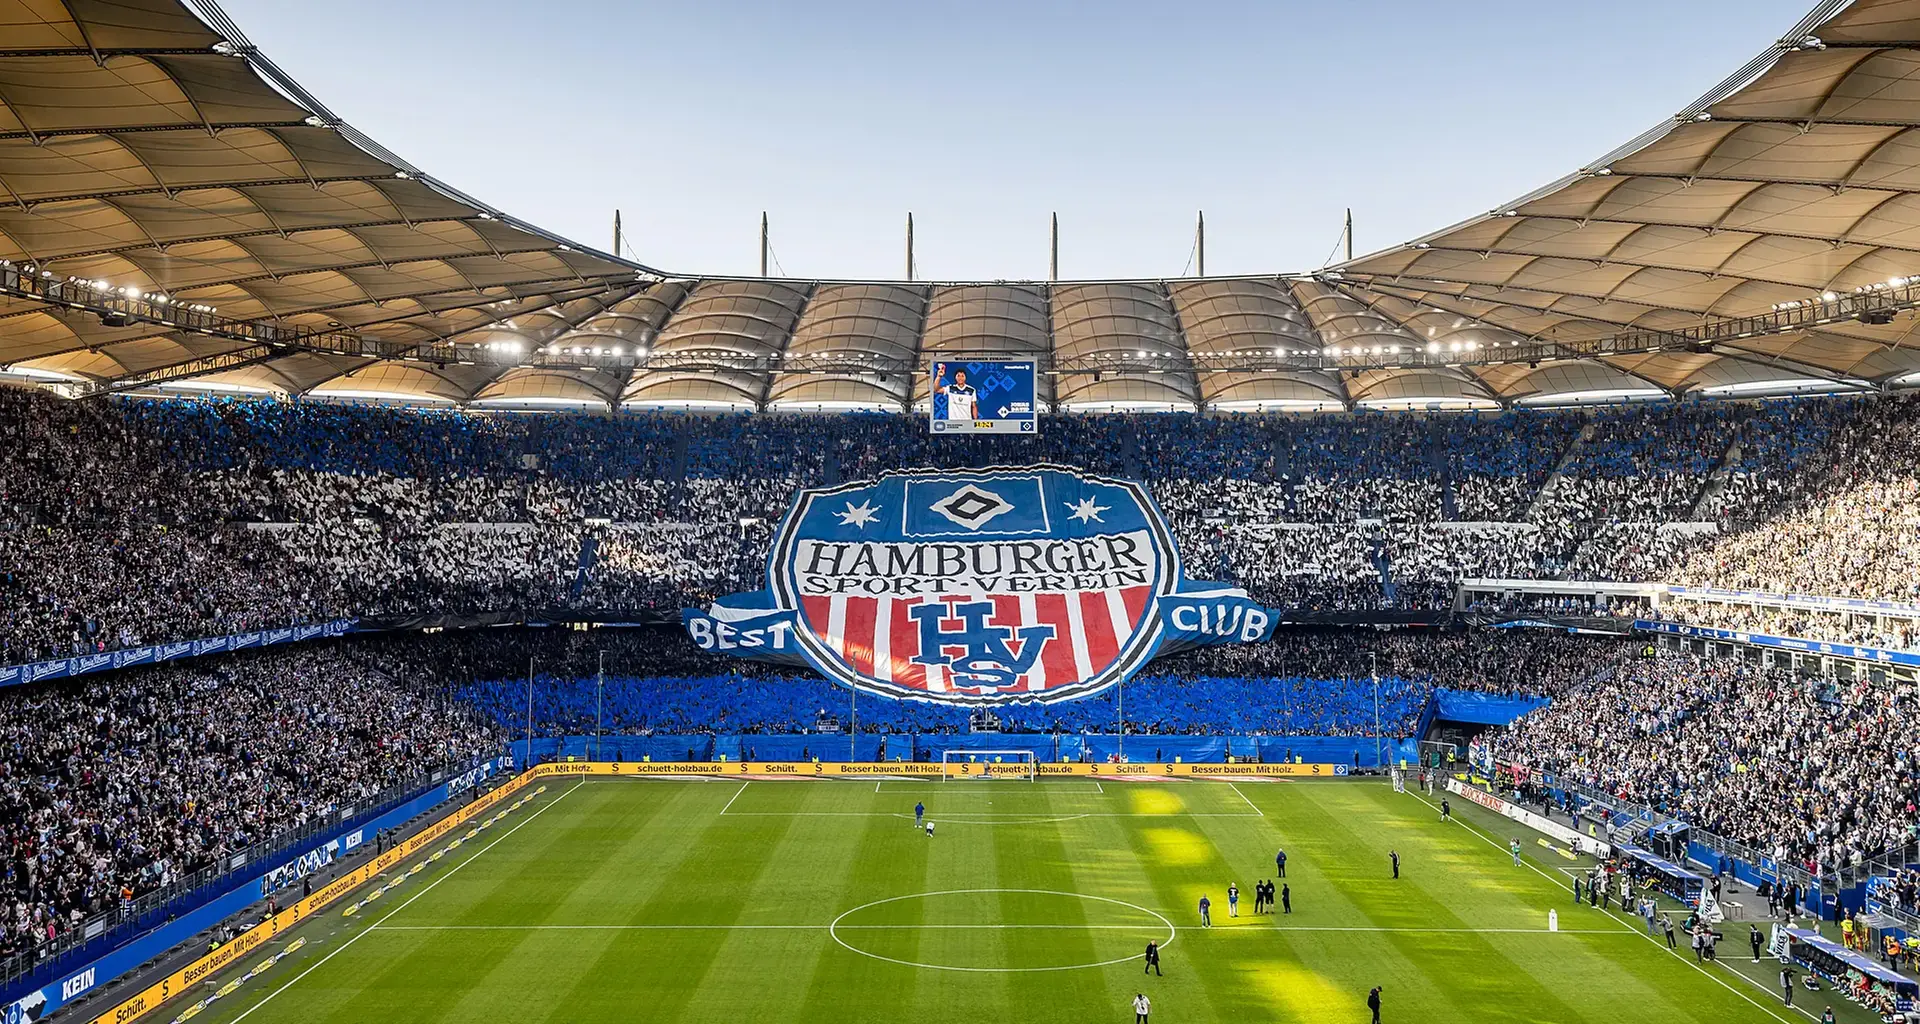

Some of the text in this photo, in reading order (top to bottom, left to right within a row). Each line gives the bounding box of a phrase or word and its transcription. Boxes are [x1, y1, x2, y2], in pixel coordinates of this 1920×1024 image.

[803, 536, 1147, 577] HAMBURGER
[1171, 604, 1268, 642] CLUB
[690, 618, 792, 649] BEST
[555, 764, 569, 773] Mit
[571, 764, 594, 773] Holz.
[637, 763, 722, 774] schuett-holzbau.de
[765, 763, 798, 773] Schütt.
[841, 764, 943, 773] Besser bauen. Mit Holz.
[1116, 764, 1148, 773] Schütt.
[1191, 765, 1294, 774] Besser bauen. Mit Holz.
[1460, 783, 1482, 801] BLOCK
[184, 960, 209, 984] Besser
[209, 954, 233, 970] bauen.
[233, 941, 245, 957] Mit
[244, 931, 261, 950] Holz.
[62, 967, 95, 1001] KEIN
[116, 997, 147, 1024] Schütt.
